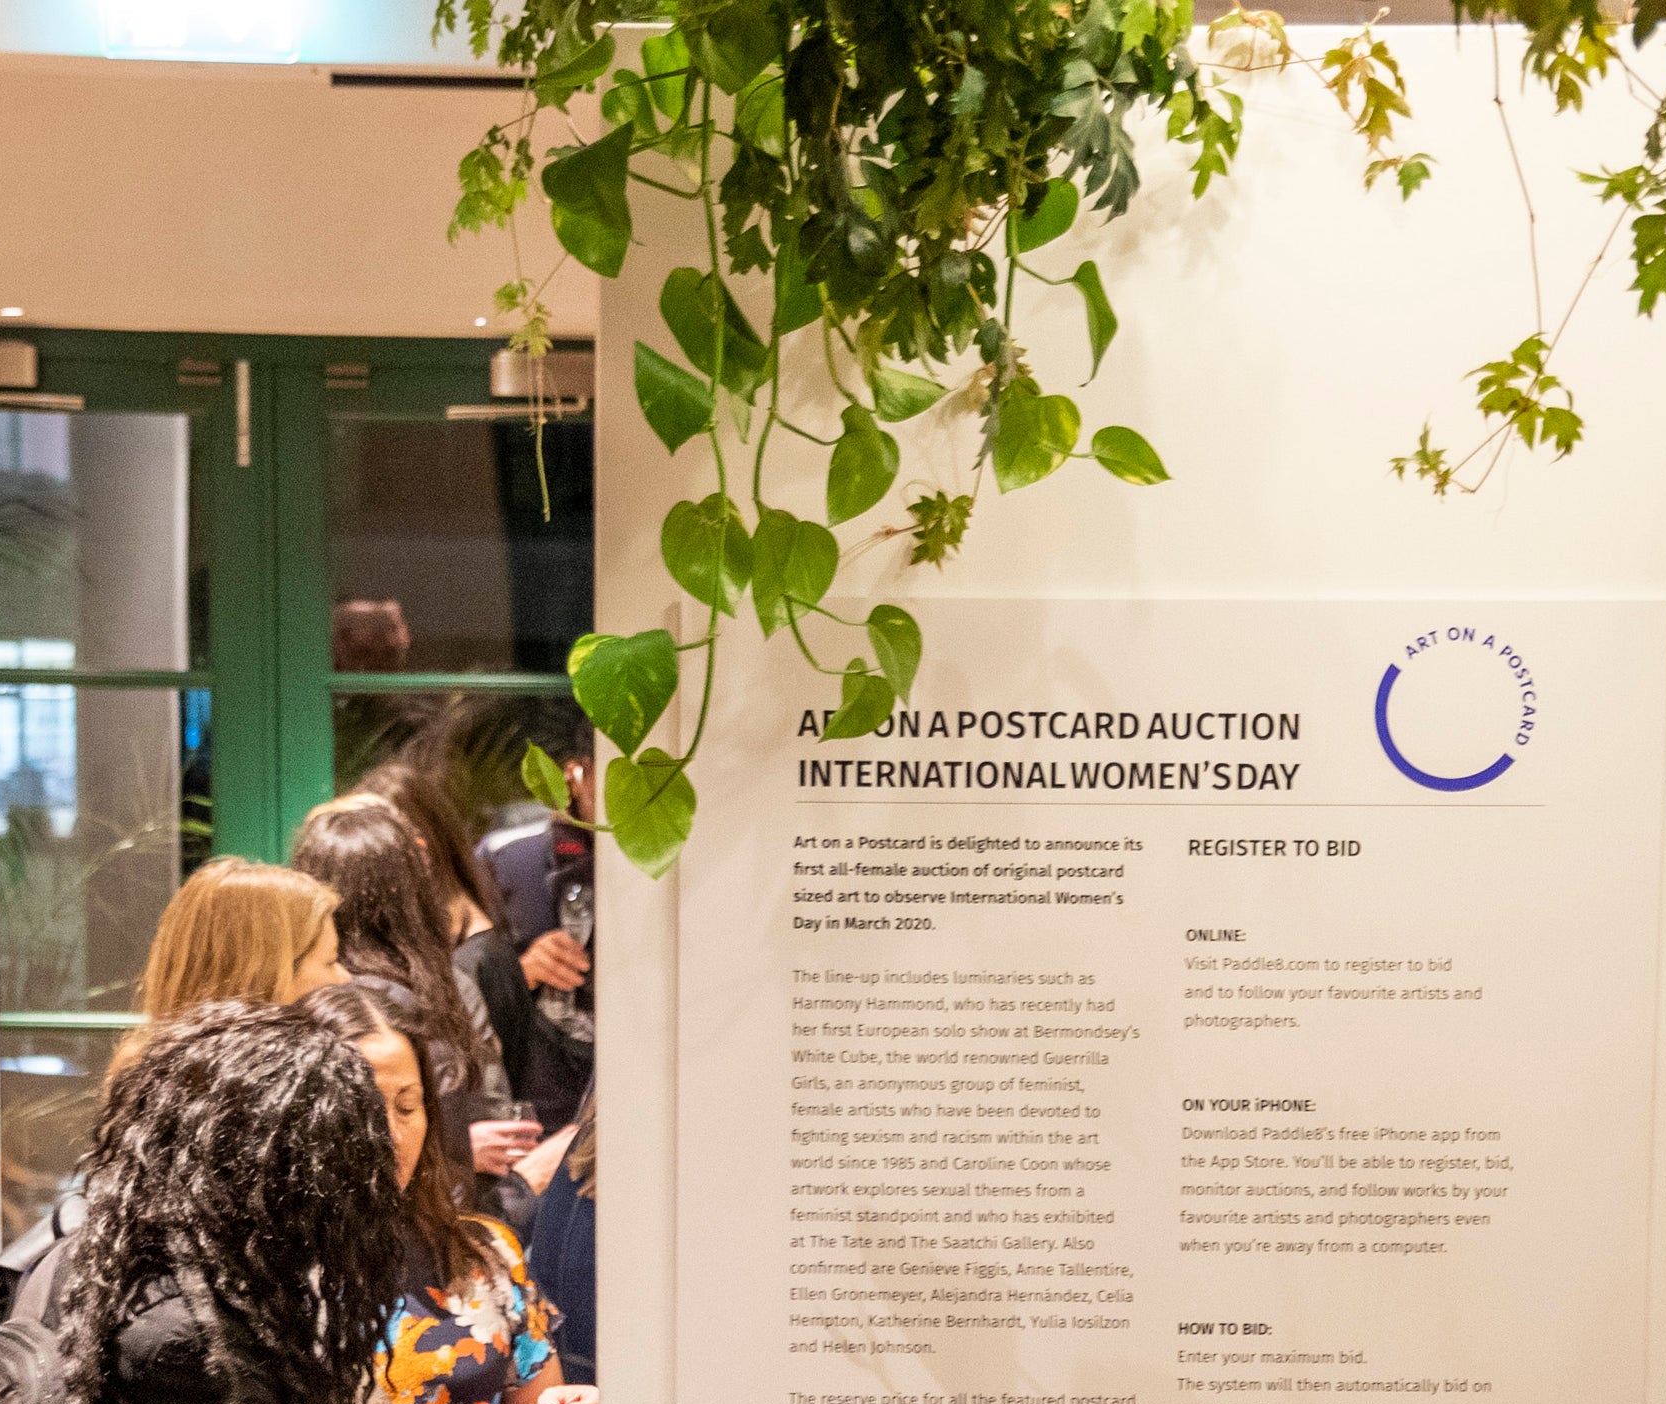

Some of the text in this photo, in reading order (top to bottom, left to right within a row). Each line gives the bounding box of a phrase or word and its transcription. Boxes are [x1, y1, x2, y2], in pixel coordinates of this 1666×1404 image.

[1405, 627, 1537, 746] ART ON A POSTCARD
[928, 711, 949, 738] A
[958, 711, 1140, 739] POSTCARD
[1147, 713, 1300, 740] AUCTION
[800, 760, 1300, 790] INTERNATIONAL WOMEN'S DAY
[793, 835, 1143, 853] Art on a Postcard is delighted to announce its
[1188, 839, 1361, 856] REGISTER TO BID
[793, 863, 1124, 881] first all-female auction of original postcard
[793, 890, 1124, 904] sized art to observe International Women's
[793, 916, 935, 933] Day in March 2020.
[1185, 929, 1245, 941] ONLINE:
[1185, 957, 1452, 974] Visit Paddle8.com to register to bid
[792, 970, 1095, 987] The line-up includes luminaries such as
[1184, 985, 1483, 1002] and to follow your favourite artists and
[1184, 1015, 1299, 1031] photographers.
[1182, 1097, 1315, 1111] ON YOUR iPHONE:
[1182, 1126, 1501, 1144] Download Paddle8's free iPhone app from
[1178, 1322, 1271, 1335] HOW TO BID:
[789, 1340, 936, 1354] and Helen Johnson.
[1177, 1350, 1368, 1367] Enter your maximum bid.
[1177, 1377, 1492, 1395] The system will then automatically bid on
[789, 1392, 816, 1404] The
[821, 1395, 876, 1404] reserve
